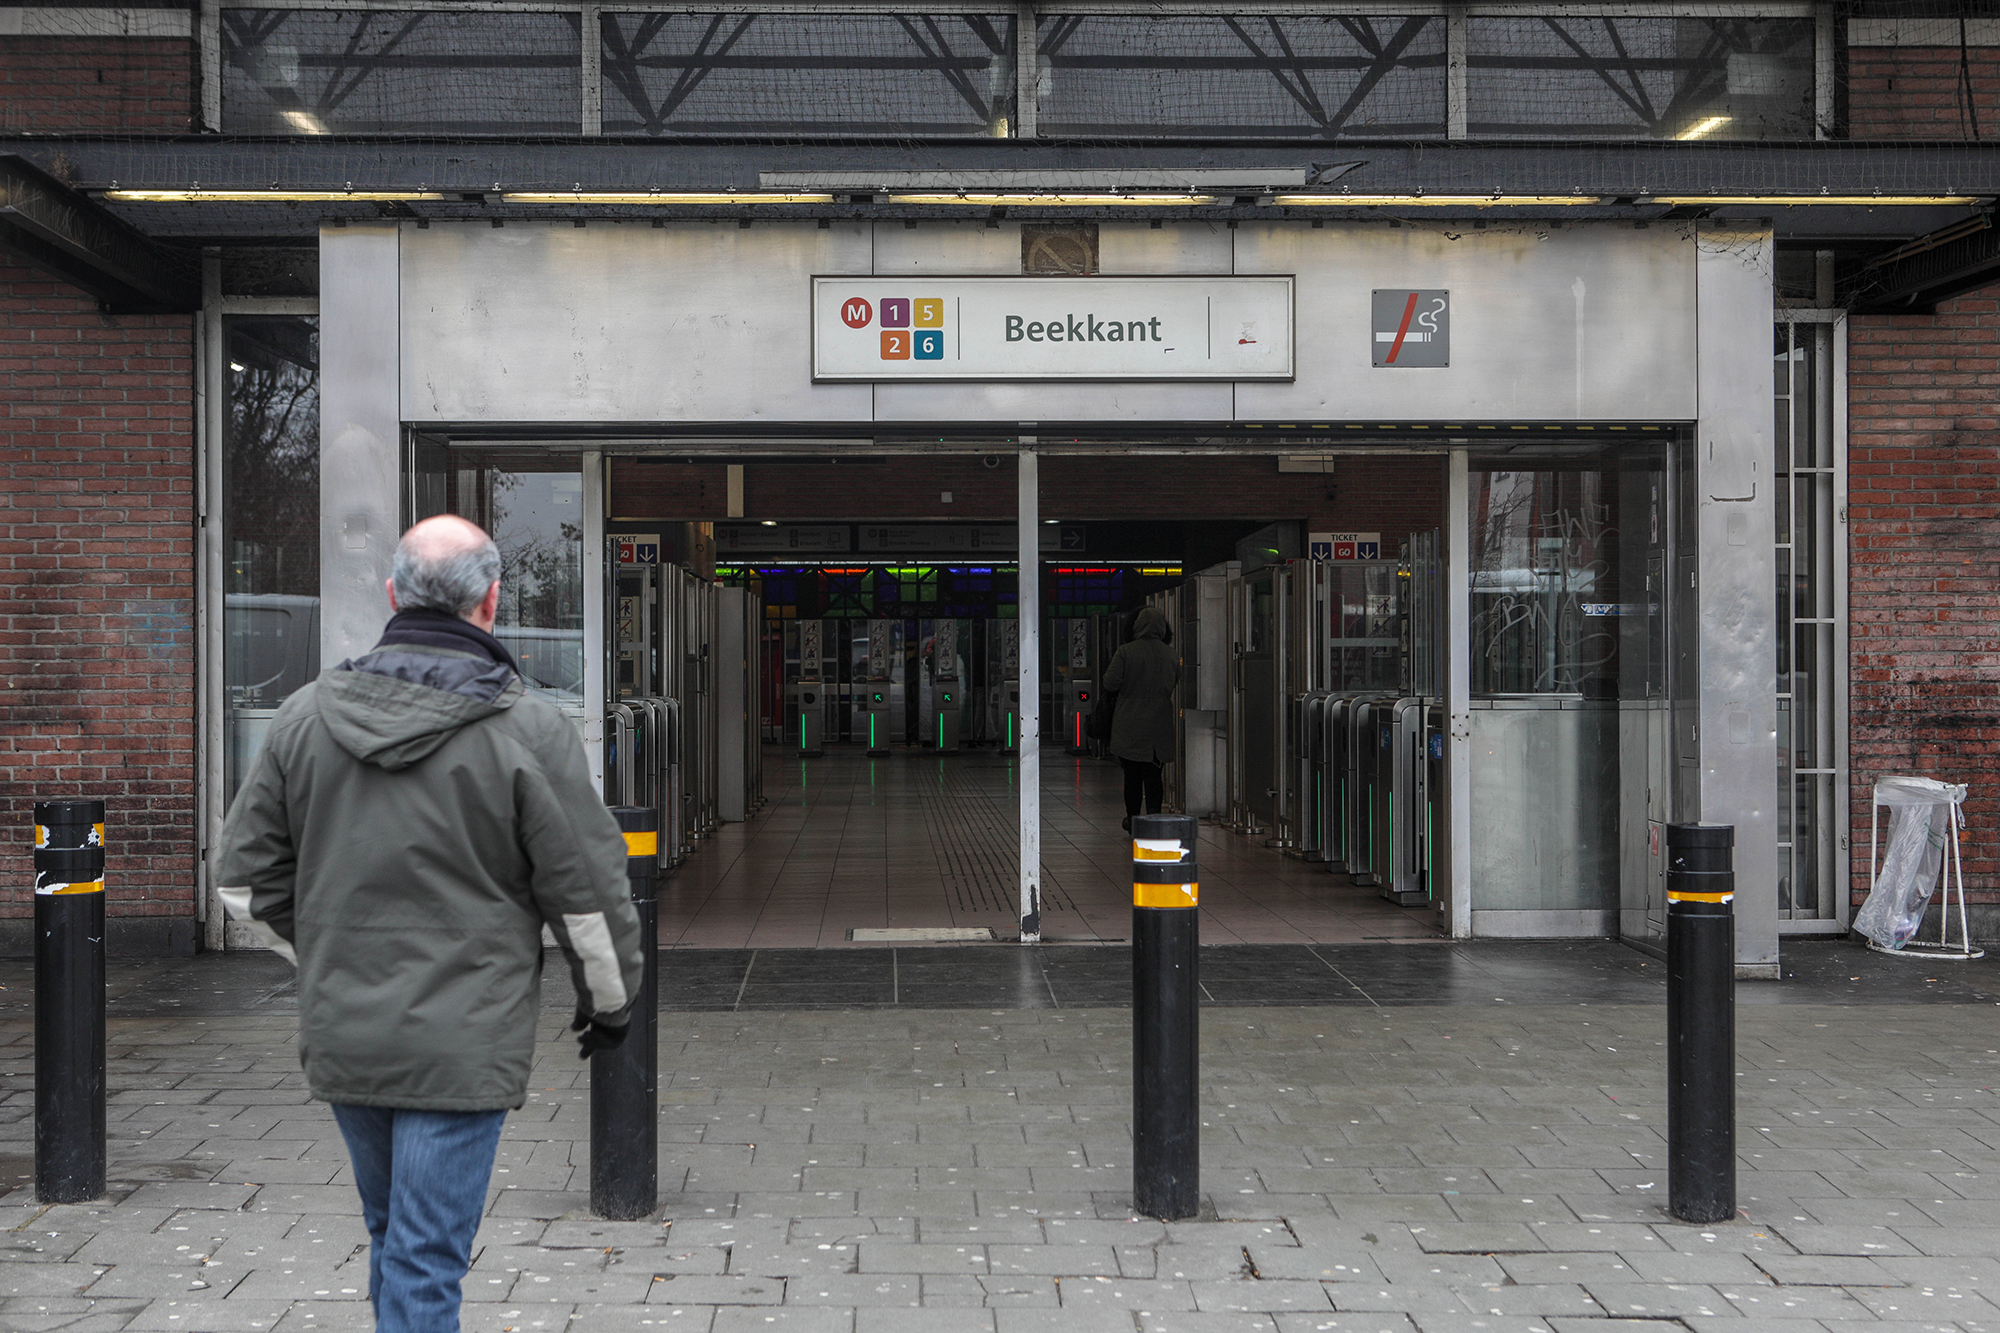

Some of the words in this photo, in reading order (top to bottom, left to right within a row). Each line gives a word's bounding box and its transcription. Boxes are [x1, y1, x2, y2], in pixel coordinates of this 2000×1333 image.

[847, 304, 866, 322] M
[889, 305, 898, 321] 1
[923, 305, 934, 321] 5
[1005, 313, 1162, 343] Beekkant
[889, 337, 900, 353] 2
[923, 337, 934, 353] 6
[1338, 547, 1351, 557] GO
